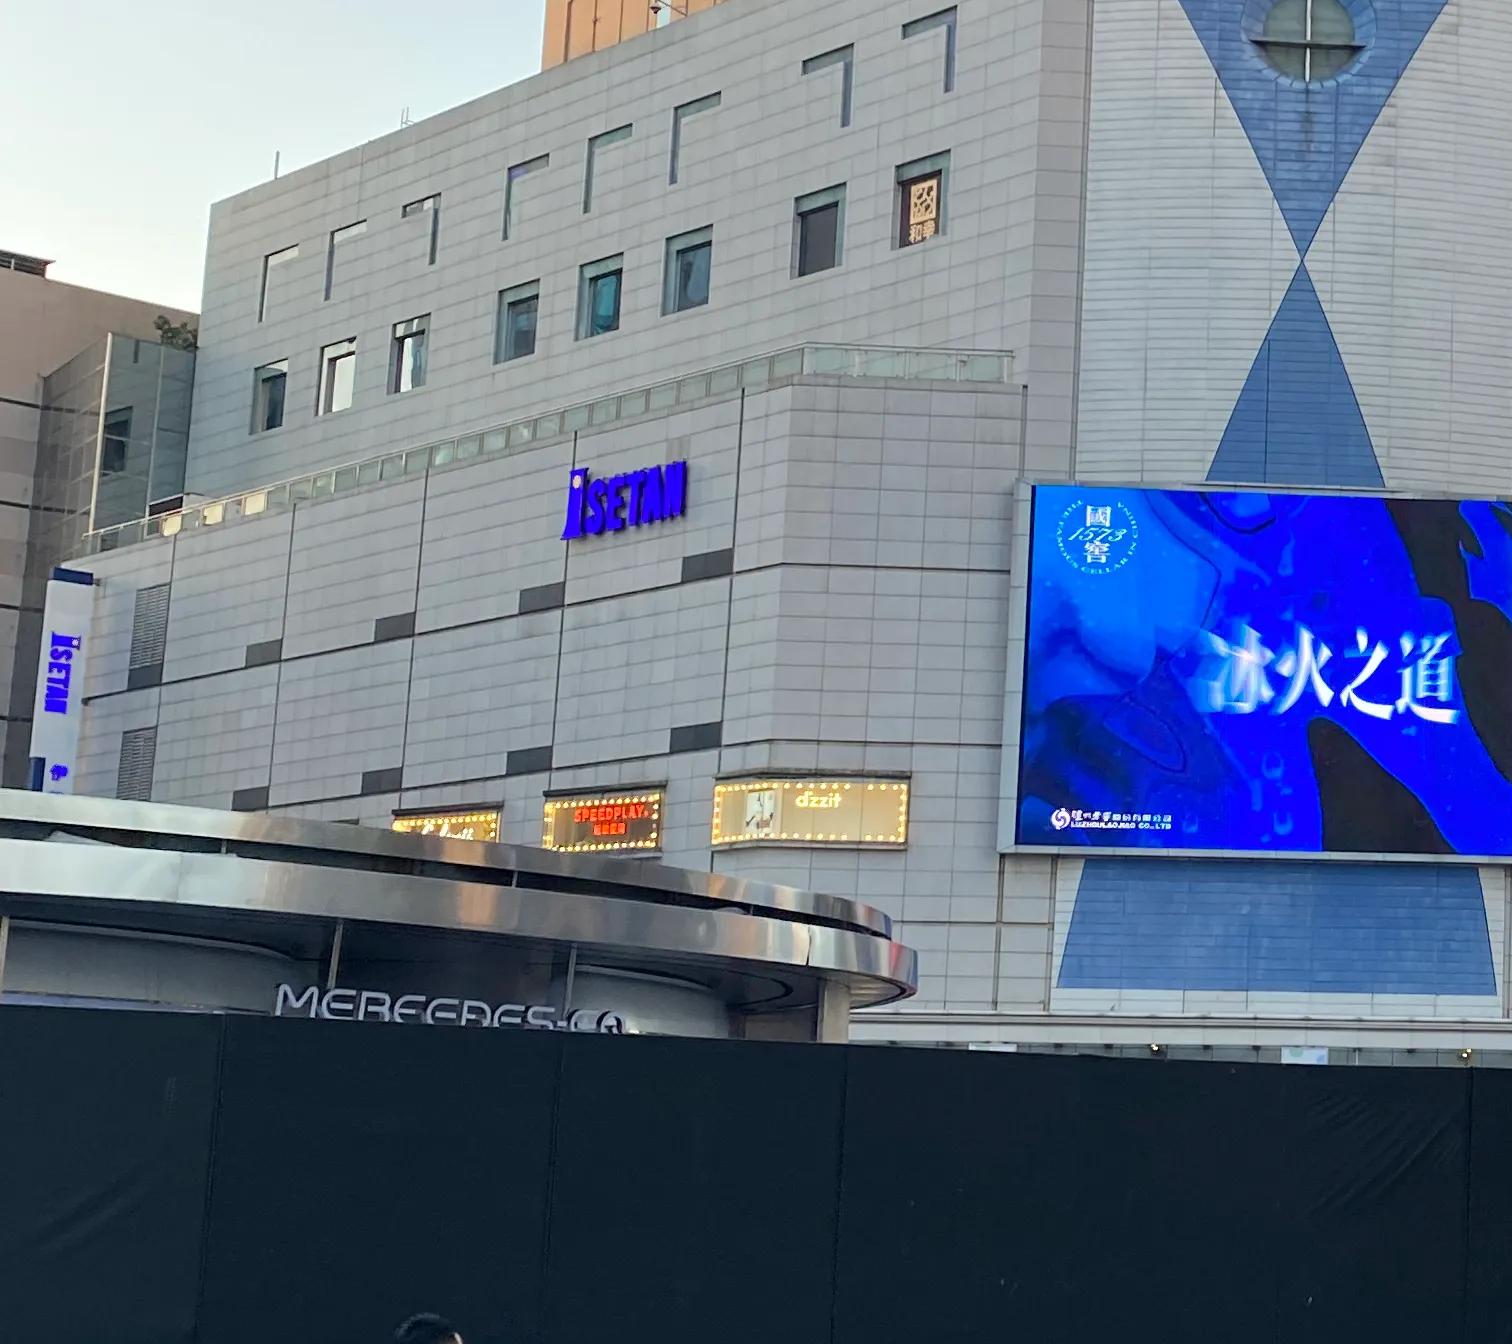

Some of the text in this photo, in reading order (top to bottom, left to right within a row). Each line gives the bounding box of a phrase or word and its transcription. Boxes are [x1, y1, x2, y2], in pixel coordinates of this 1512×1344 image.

[1068, 527, 1127, 542] 1573
[1207, 623, 1461, 725] 冰火之道
